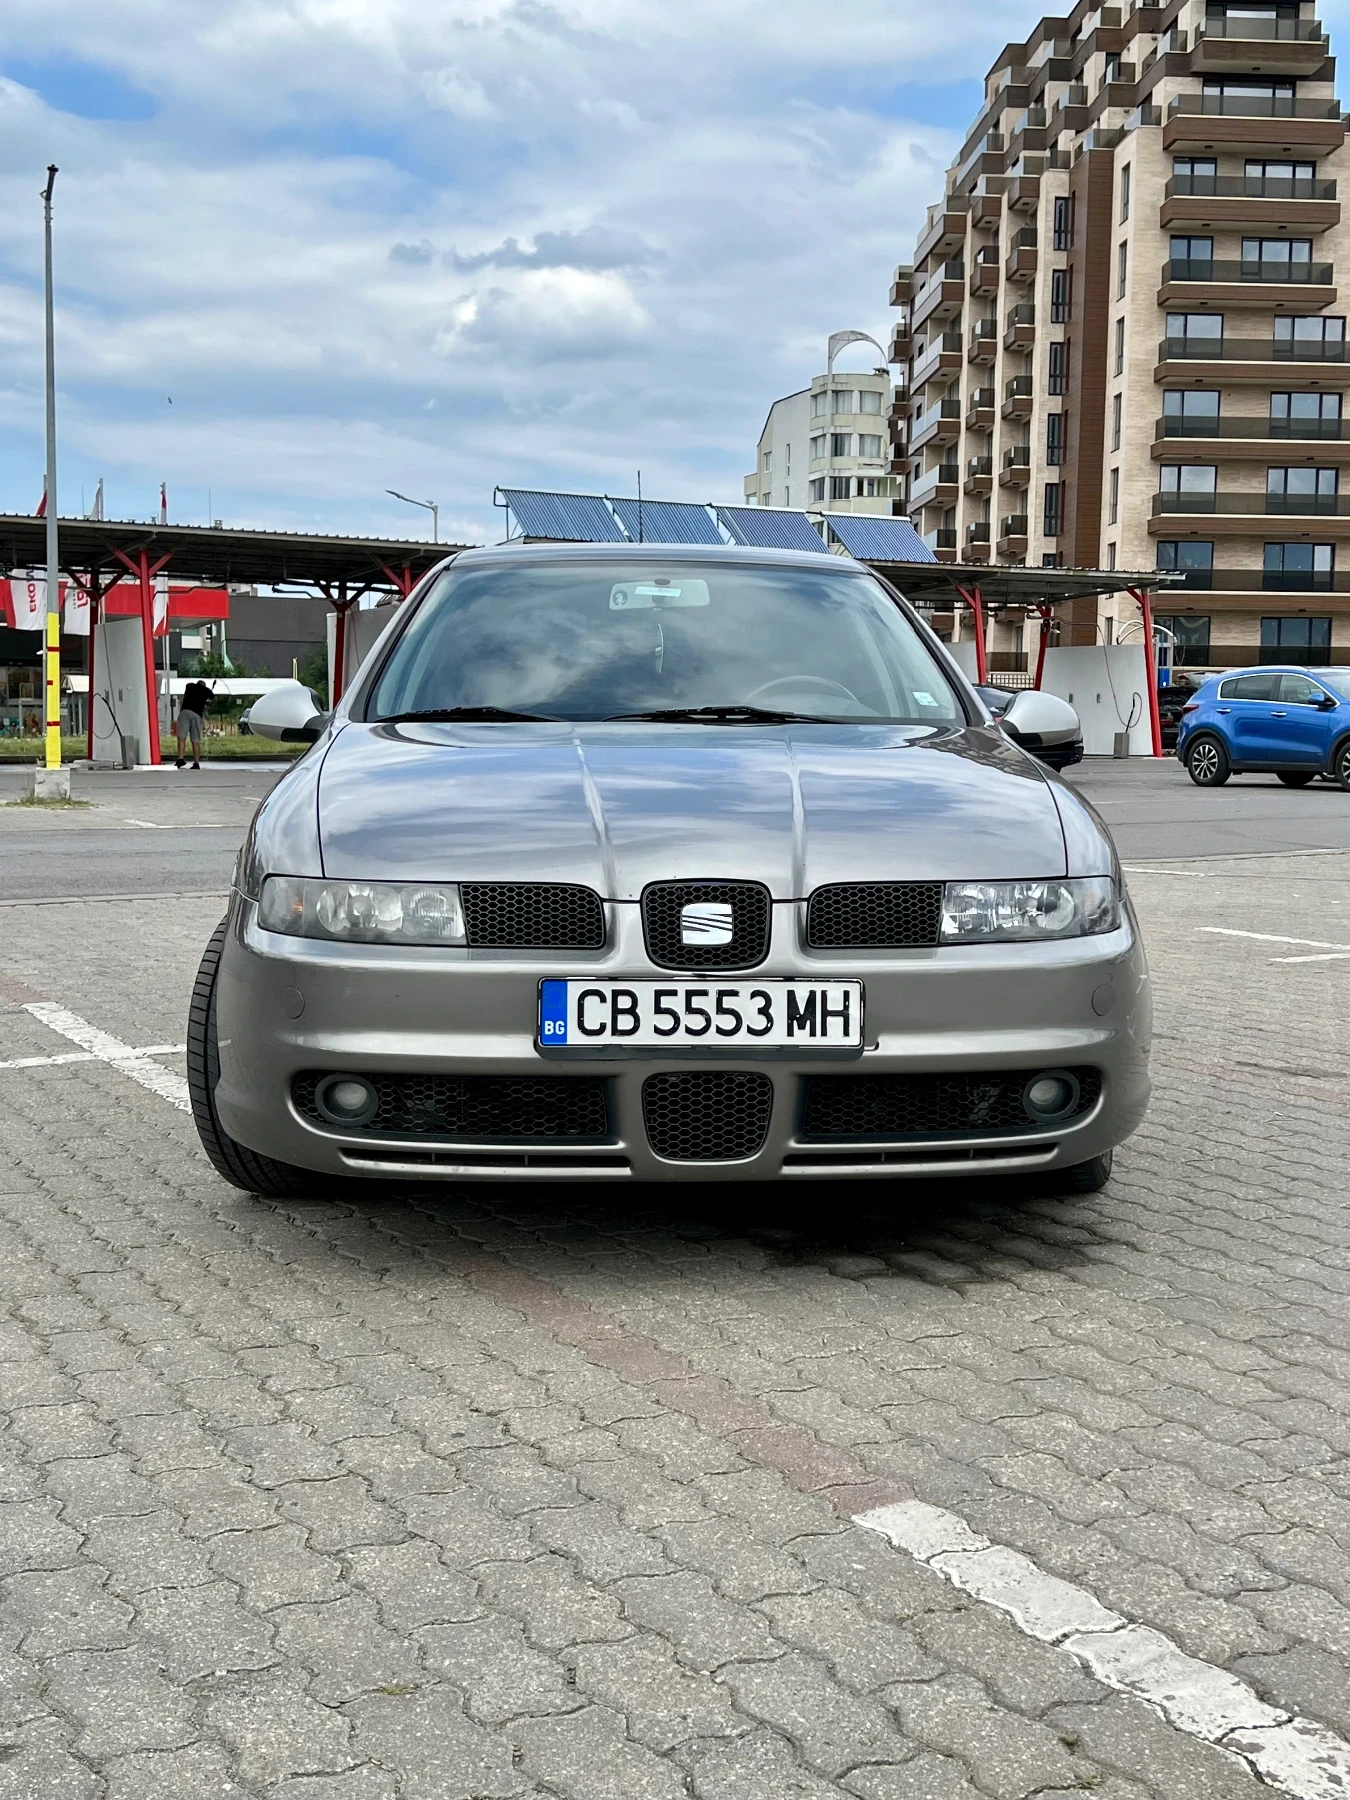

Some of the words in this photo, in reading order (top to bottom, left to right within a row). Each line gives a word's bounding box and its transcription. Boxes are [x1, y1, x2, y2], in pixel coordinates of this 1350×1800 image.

[544, 1020, 566, 1036] BG
[577, 988, 641, 1037] CB
[653, 988, 774, 1037] 5553
[786, 988, 850, 1037] MH
